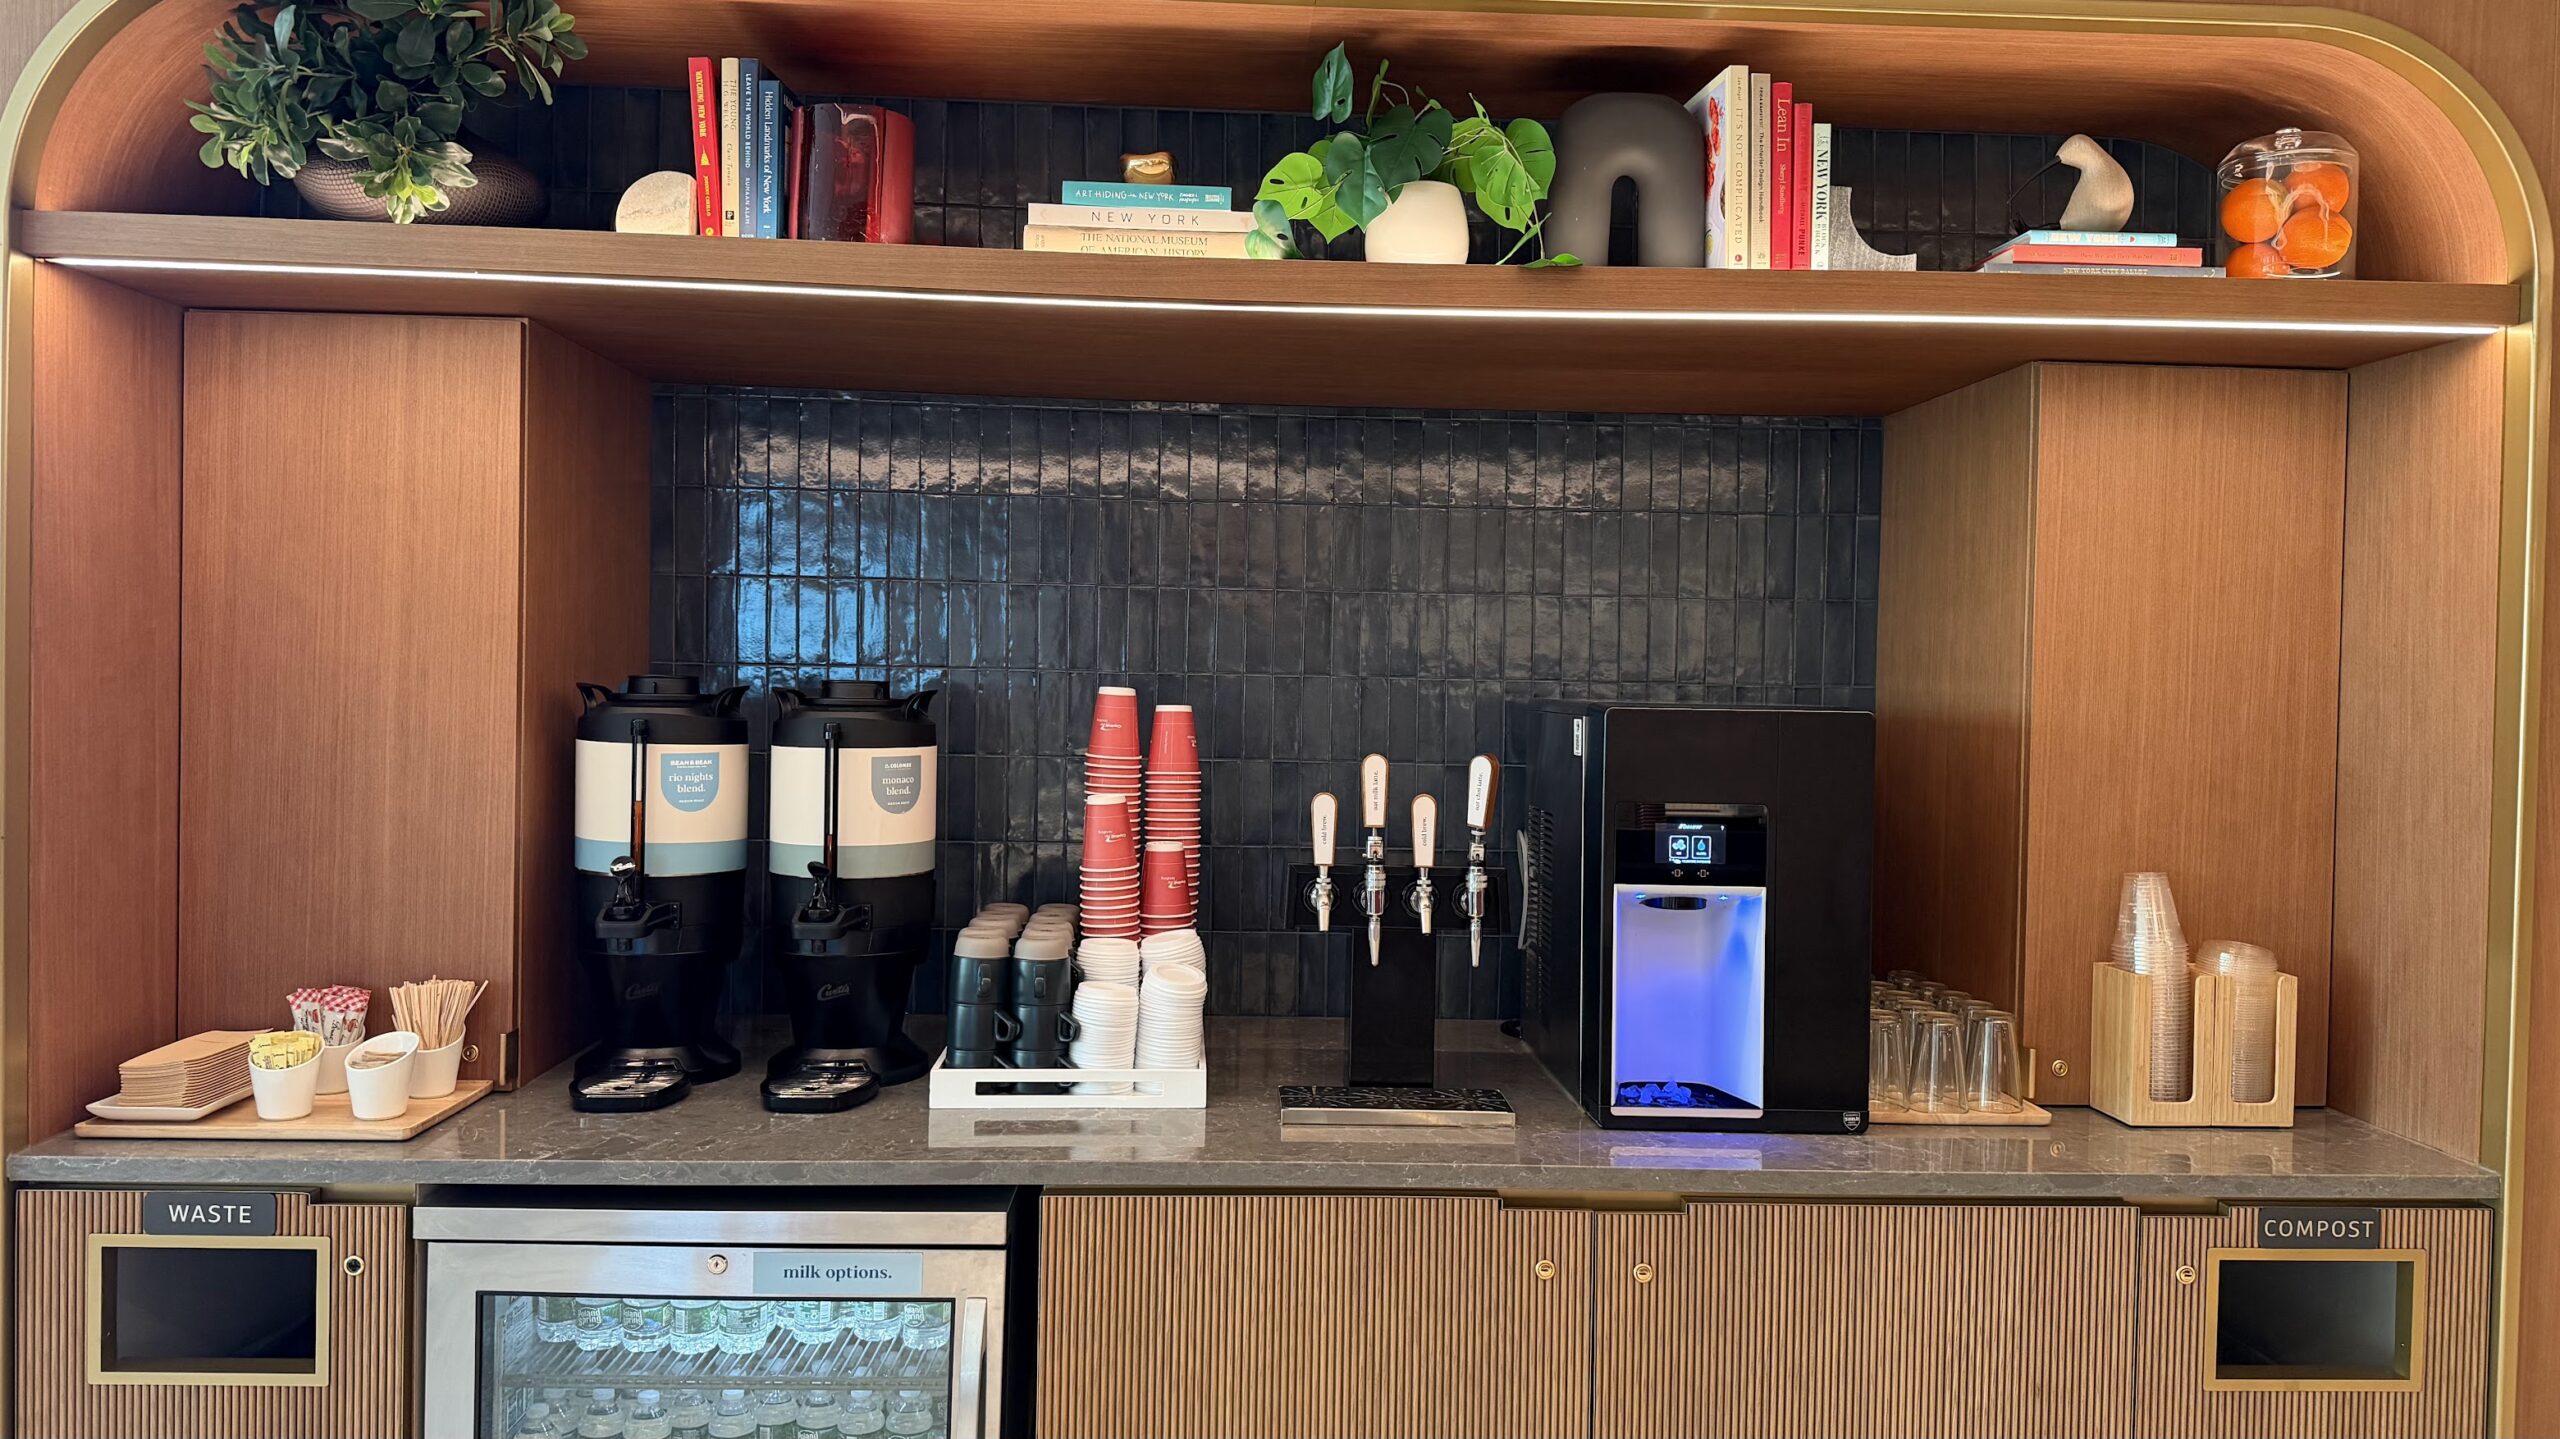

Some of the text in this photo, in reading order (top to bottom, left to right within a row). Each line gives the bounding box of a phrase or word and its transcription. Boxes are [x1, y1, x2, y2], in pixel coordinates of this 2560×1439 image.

[695, 70, 707, 138] WATCHING NEW YORK
[763, 91, 773, 120] Hidden
[744, 73, 752, 168] LEAVE THE WORLD BEHIND
[1777, 98, 1791, 152] Lean In
[763, 121, 773, 164] Landmarks
[763, 164, 773, 173] of
[763, 174, 772, 195] New
[1778, 163, 1786, 215] Sheryl Sandberg
[1816, 150, 1828, 220] NEW YORK
[762, 195, 772, 214] York
[1075, 190, 1093, 198] ART
[1095, 189, 1127, 200] HIDING
[1138, 192, 1156, 200] NEW
[1156, 192, 1174, 201] YORK
[1734, 162, 1743, 244] COMPLICATED
[1091, 211, 1200, 226] NEW YORK
[1082, 232, 1208, 246] THE NATIONAL MUSEUM
[1798, 228, 1806, 256] PUNKE
[668, 772, 714, 783] rio nights
[882, 776, 914, 784] monaco
[677, 784, 706, 793] blend.
[886, 786, 911, 796] blend.
[168, 1204, 252, 1224] WASTE
[2264, 1219, 2374, 1238] COMPOST
[783, 1265, 892, 1282] milk options.
